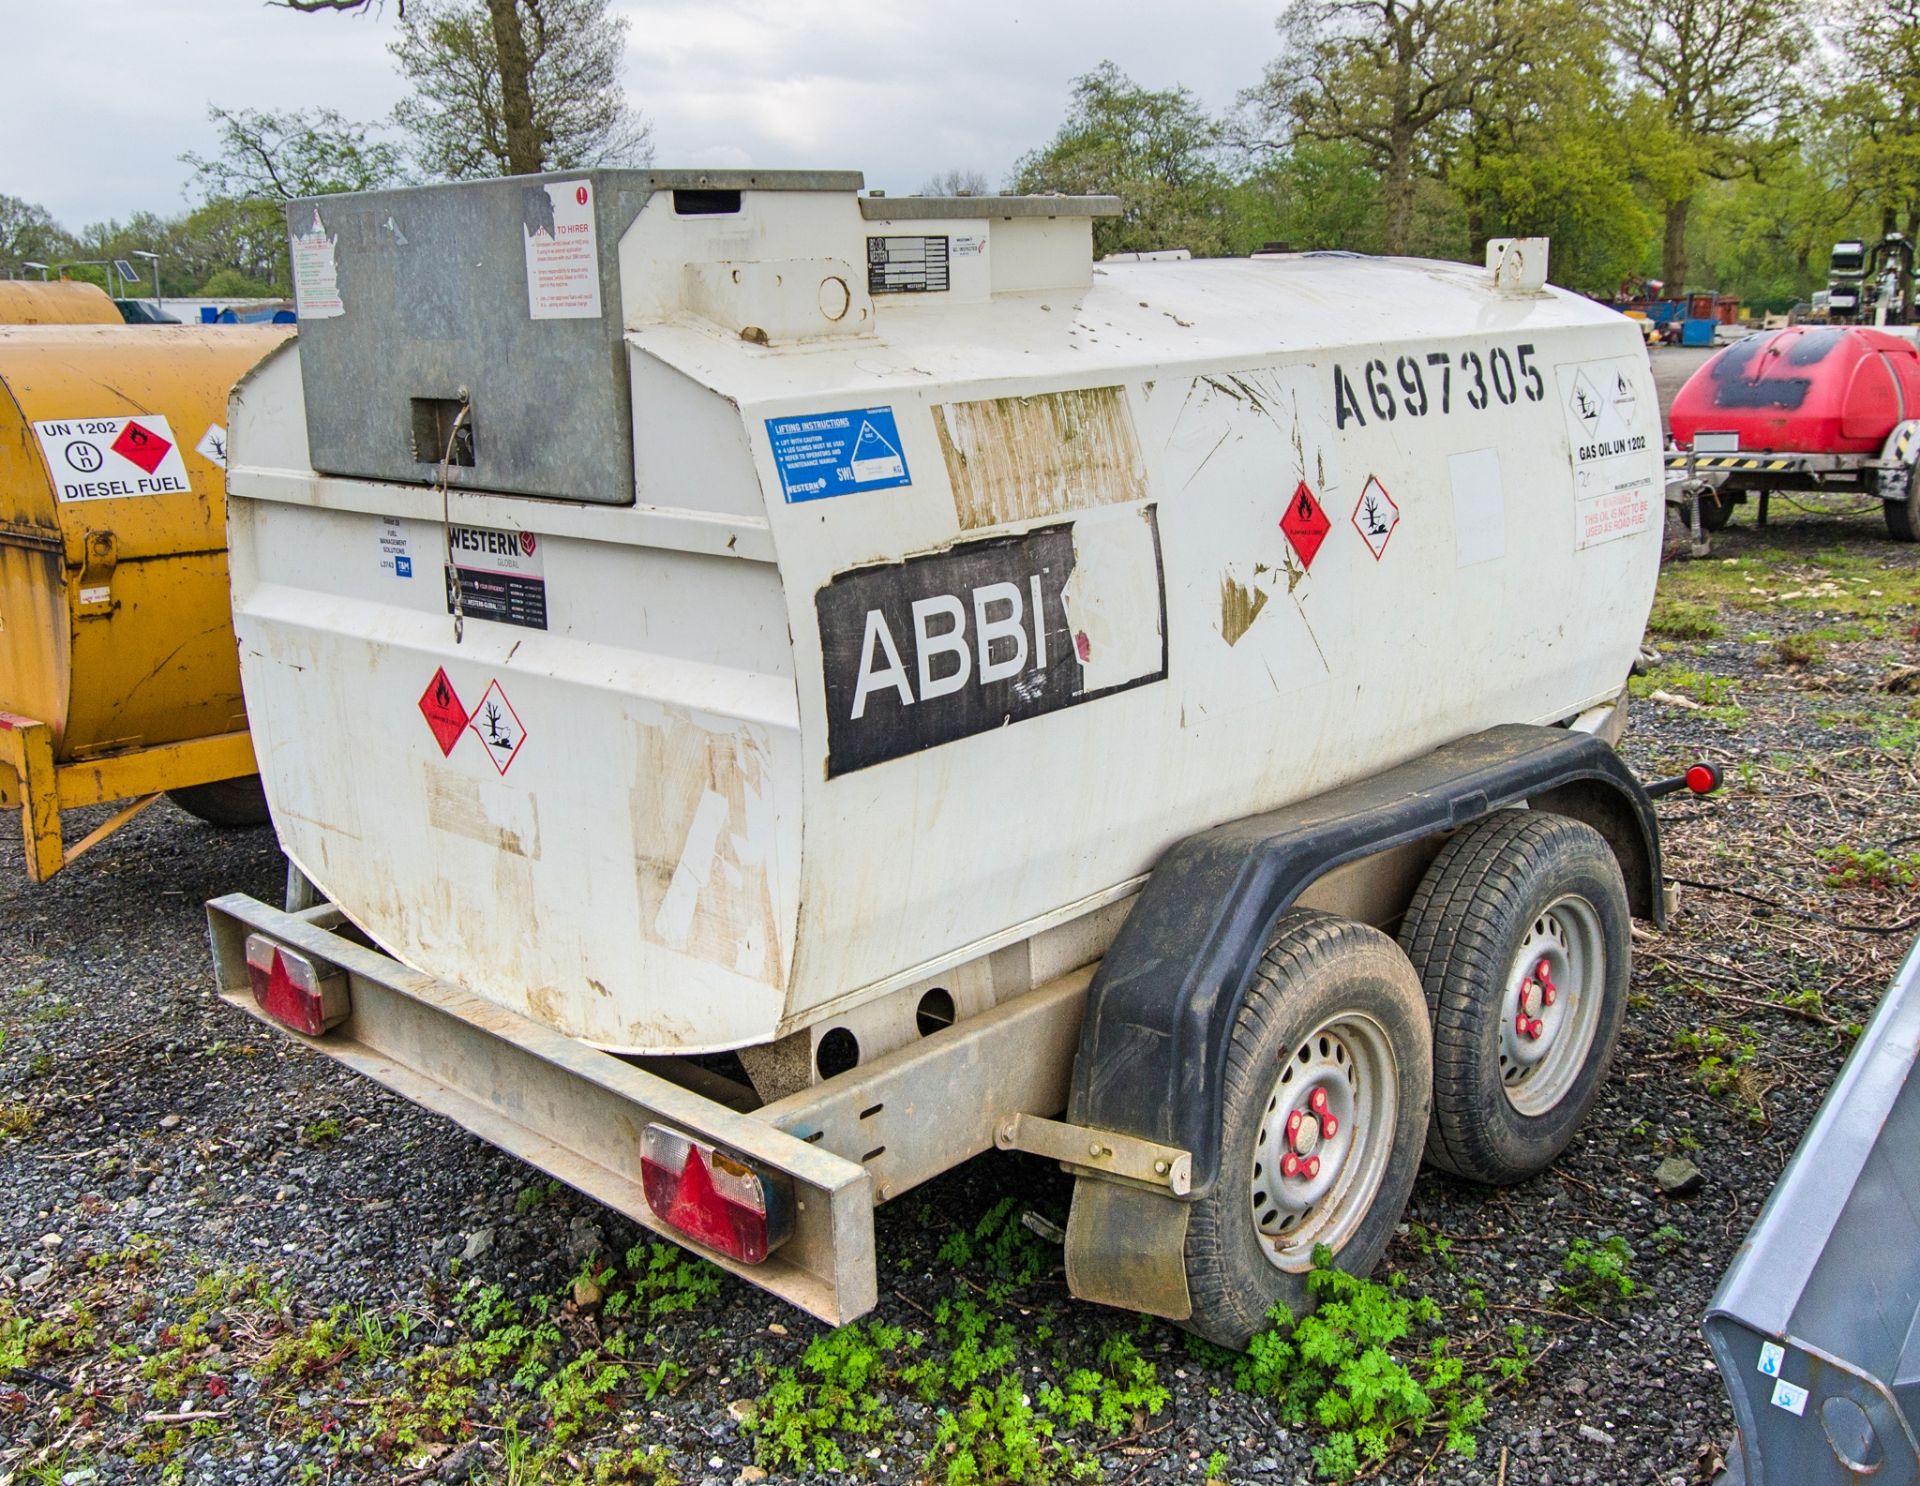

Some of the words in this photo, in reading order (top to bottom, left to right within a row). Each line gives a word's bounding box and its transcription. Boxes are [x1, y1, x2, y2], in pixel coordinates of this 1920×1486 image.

[557, 226, 566, 234] TO
[567, 223, 589, 233] HIRER
[1334, 344, 1544, 430] A697305
[43, 424, 71, 437] UN
[76, 421, 118, 434] 1202
[775, 423, 801, 434] LIFTING
[801, 417, 850, 431] INSTRUCTIONS
[790, 437, 802, 445] WITH
[803, 435, 822, 443] CAUTION
[812, 442, 825, 450] MUST
[1579, 444, 1597, 461] GAS
[1598, 442, 1612, 457] OIL
[1613, 439, 1626, 454] UN
[1627, 435, 1646, 451] 1202
[836, 466, 855, 481] SWL
[893, 465, 902, 473] KG
[64, 480, 134, 499] DIESEL
[138, 476, 186, 493] FUEL
[1584, 513, 1598, 526] THIS
[1600, 511, 1609, 521] OIL
[1611, 507, 1617, 518] IS
[1618, 504, 1630, 517] NOT
[1632, 502, 1639, 513] TO
[1639, 501, 1649, 512] BE
[1585, 524, 1602, 538] USED
[1603, 521, 1612, 533] AS
[1613, 517, 1630, 530] ROAD
[1632, 513, 1647, 526] FUEL
[447, 527, 518, 556] WESTERN
[497, 558, 520, 569] GLOBAL
[850, 574, 1047, 721] ABBI
